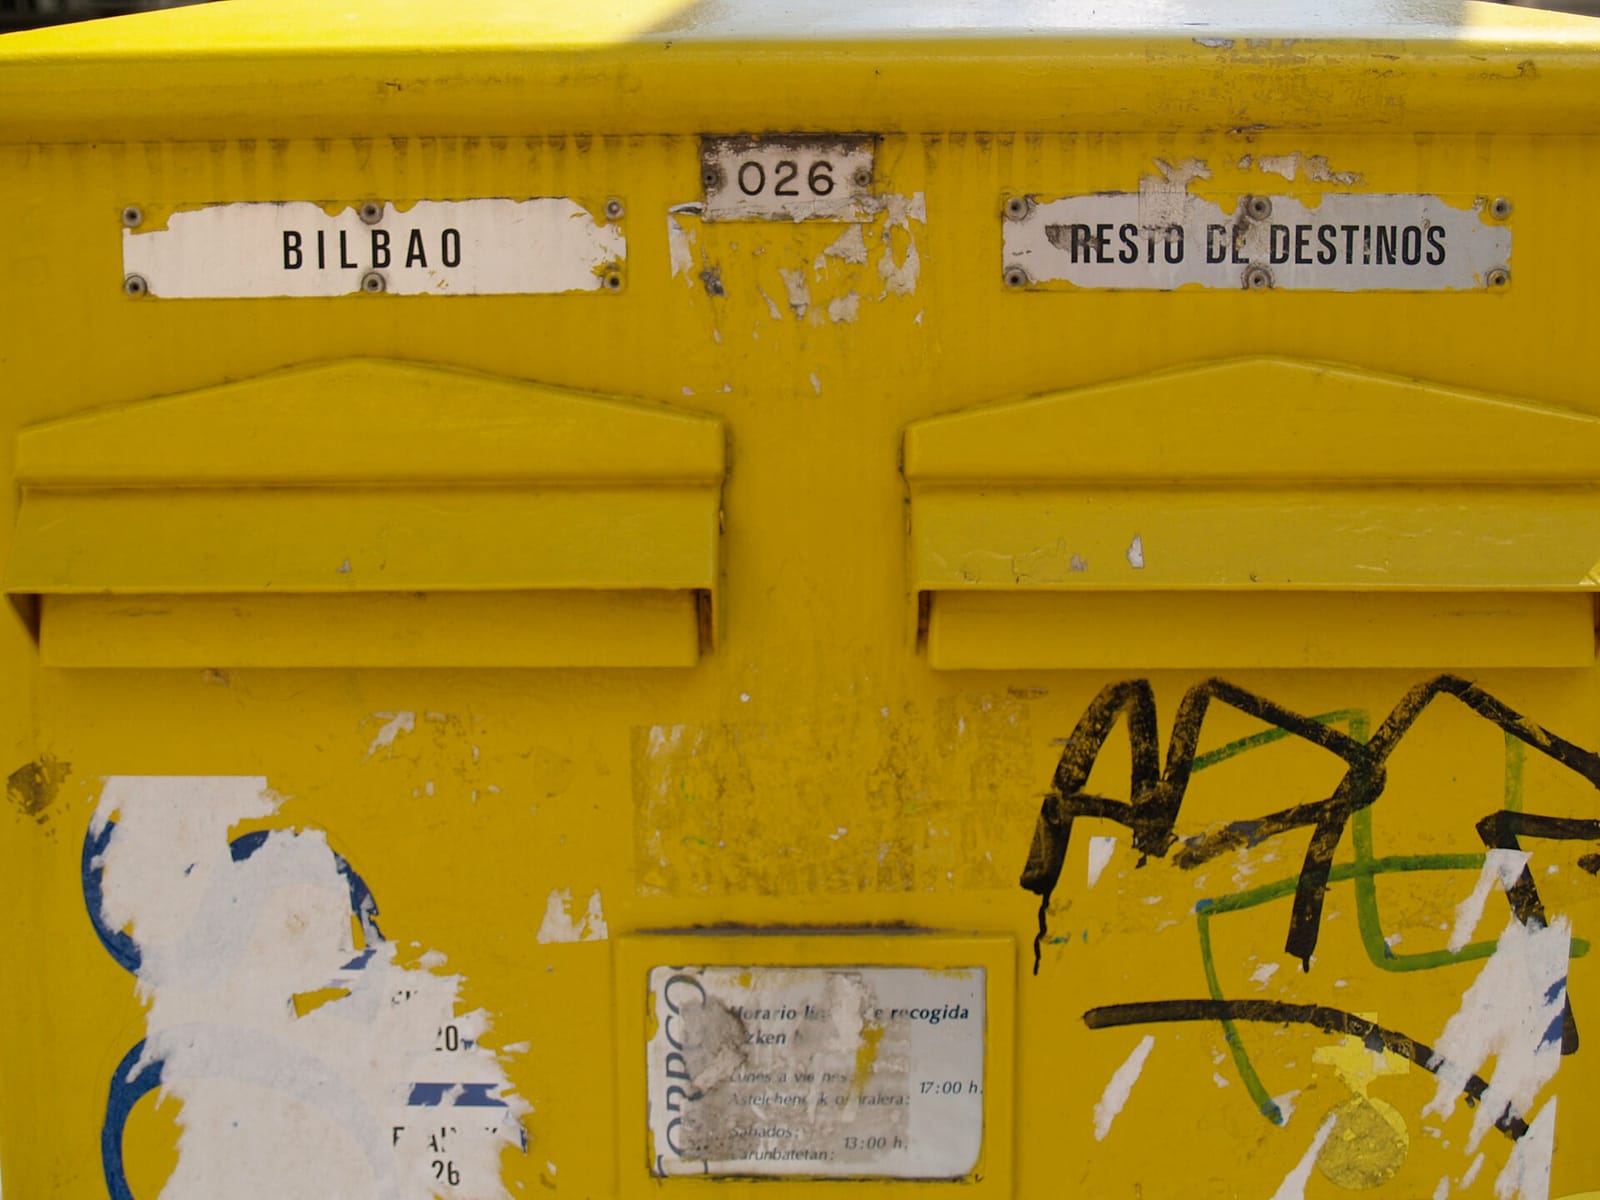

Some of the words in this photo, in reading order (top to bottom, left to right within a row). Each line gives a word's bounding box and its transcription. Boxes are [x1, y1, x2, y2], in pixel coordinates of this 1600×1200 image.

[737, 160, 834, 197] 026
[282, 228, 463, 270] BILBAO
[1269, 223, 1447, 266] DESTINOS
[919, 1080, 963, 1095] 17:00
[843, 1135, 888, 1150] 13:00
